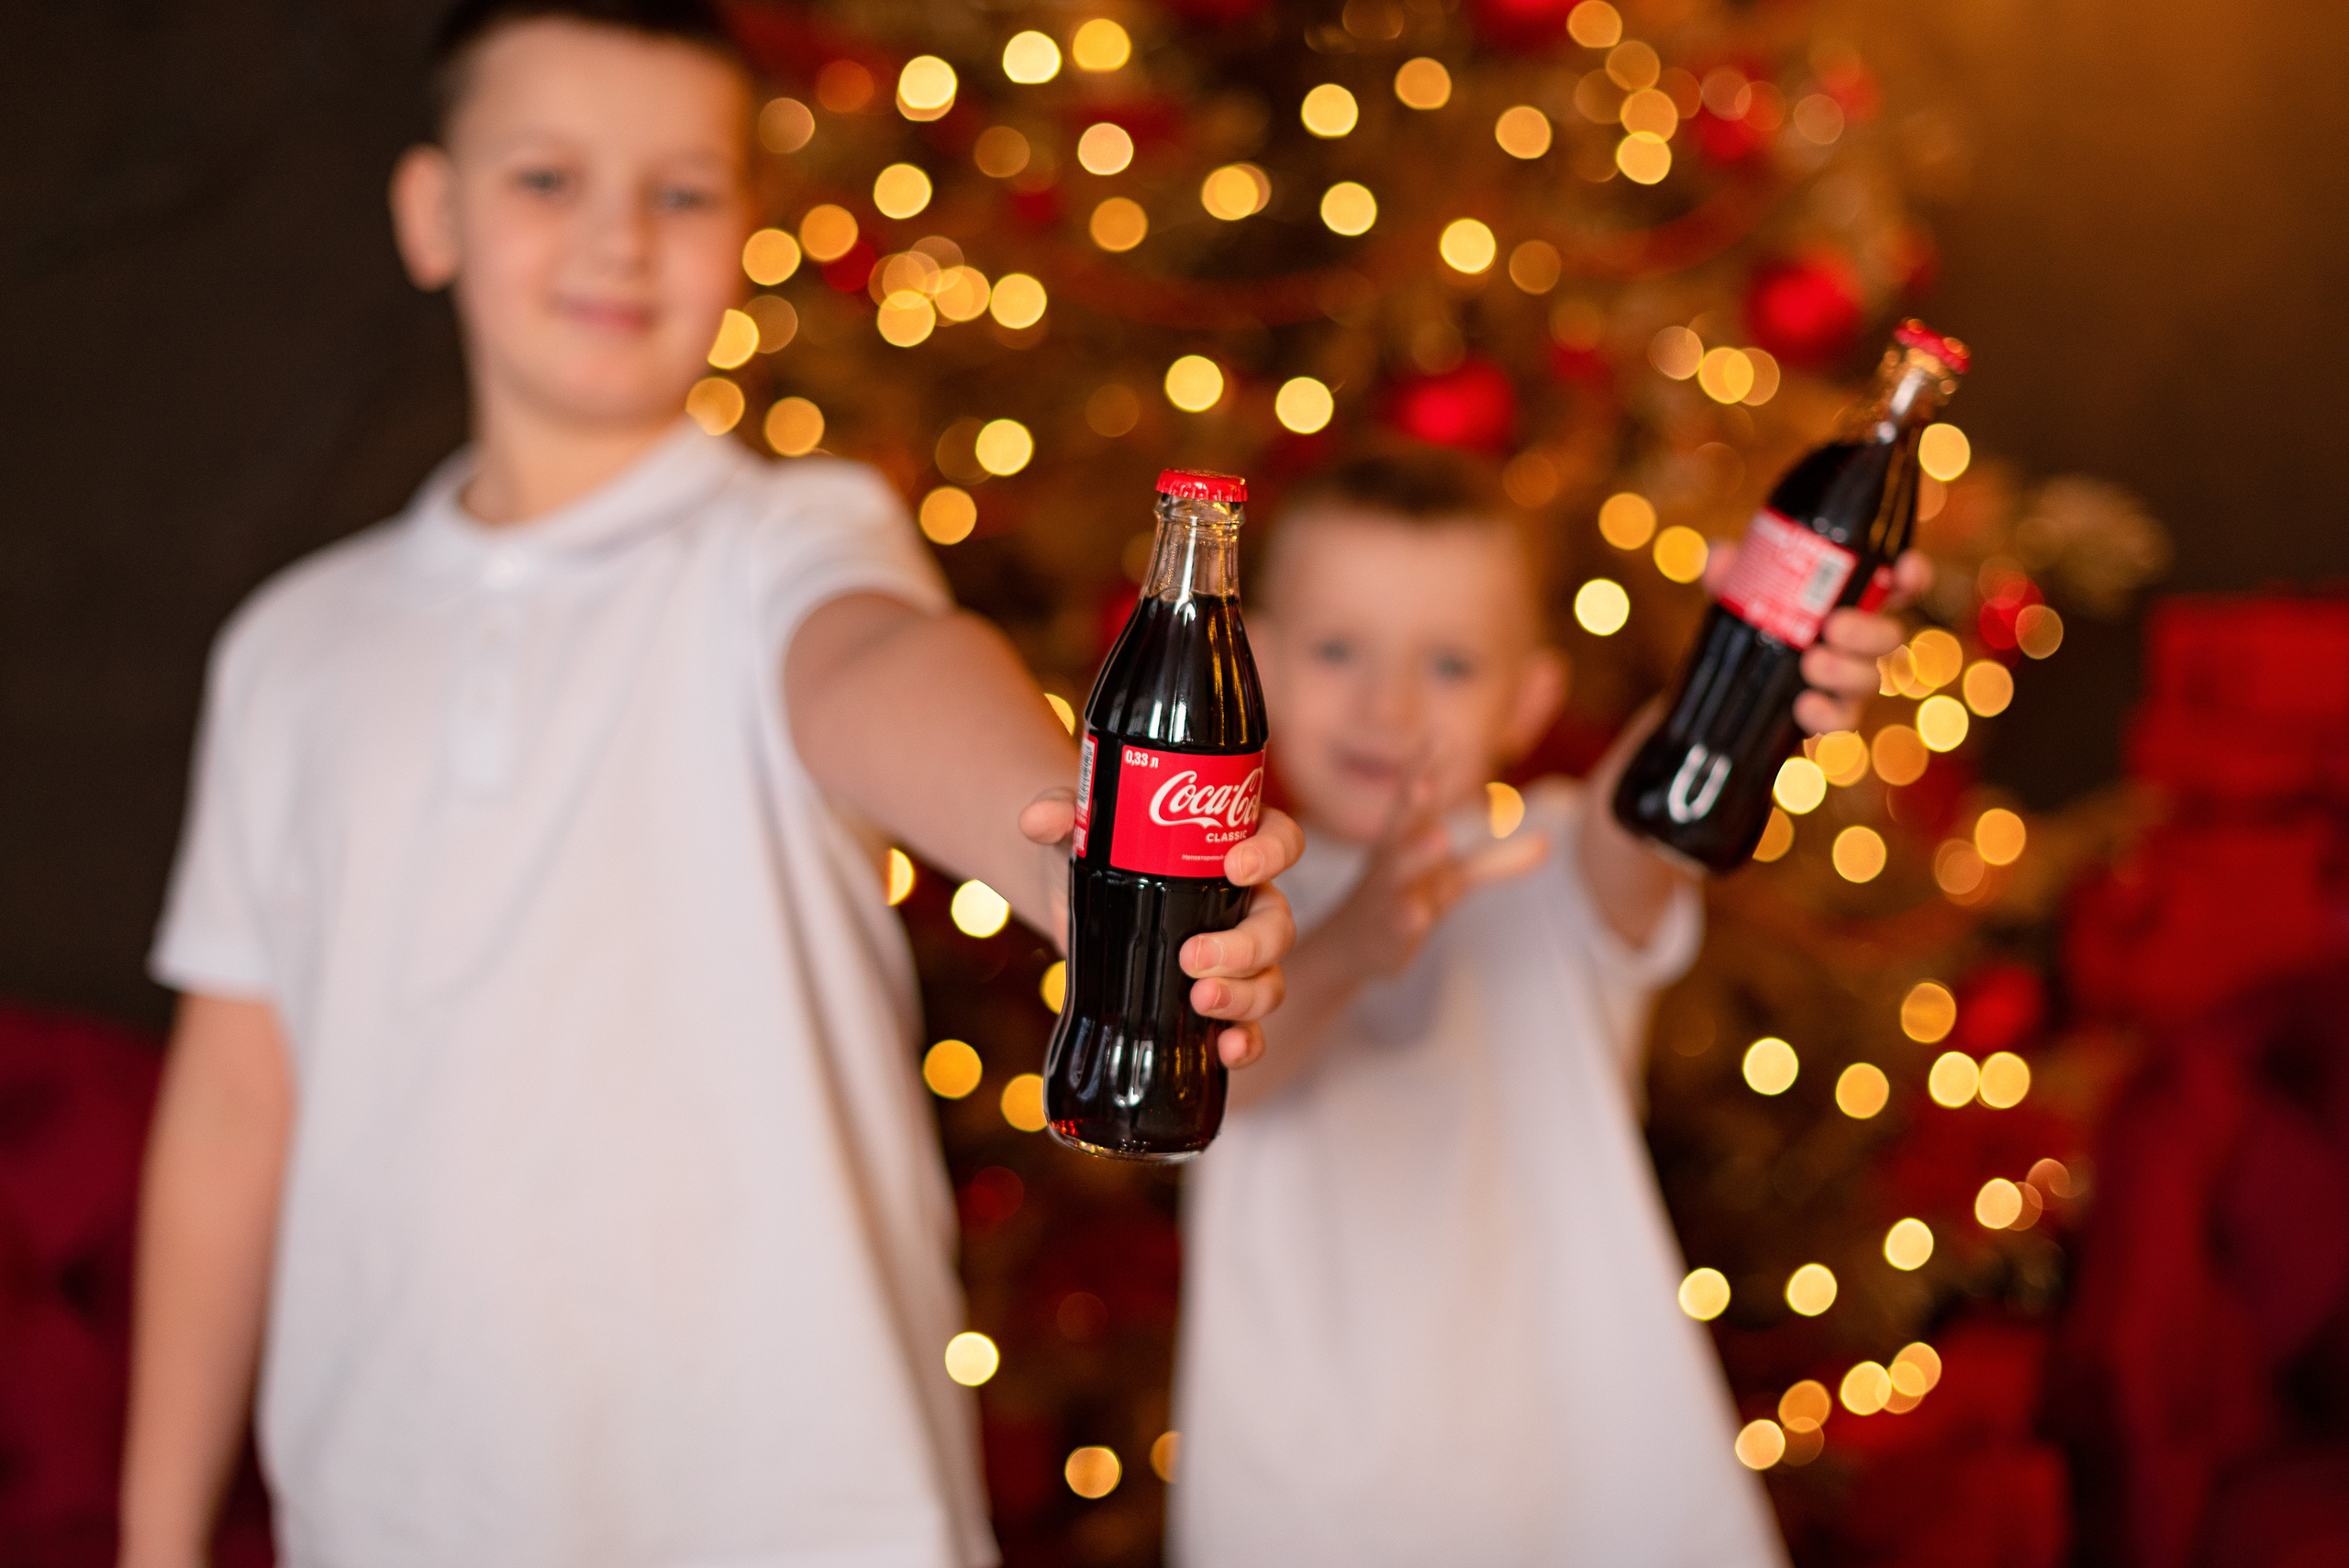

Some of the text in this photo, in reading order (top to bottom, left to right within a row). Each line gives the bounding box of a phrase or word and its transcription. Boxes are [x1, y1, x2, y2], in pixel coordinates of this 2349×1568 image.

[1125, 750, 1159, 768] 0,33 л
[1150, 766, 1264, 828] Coca-Col
[1206, 829, 1248, 843] CLASSIC
